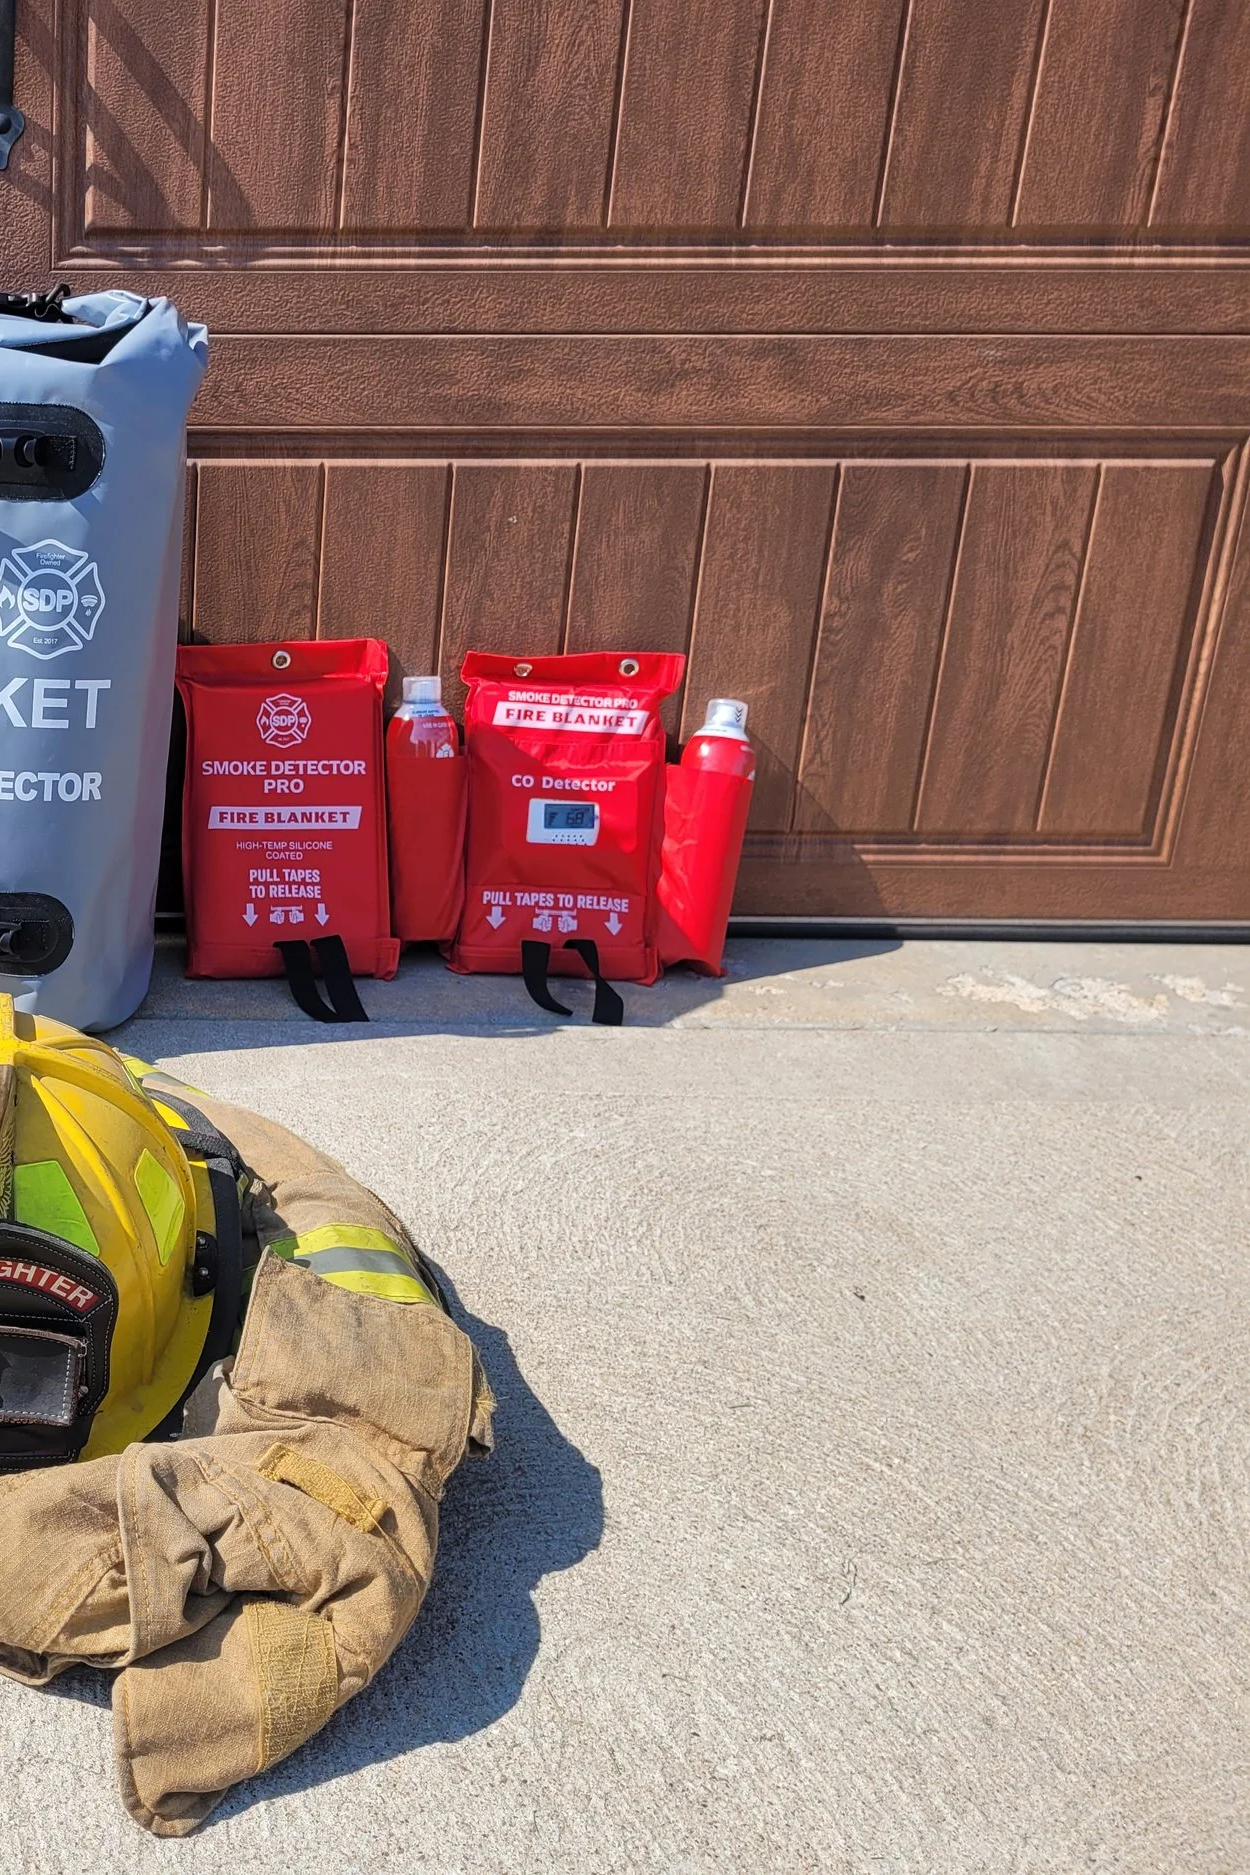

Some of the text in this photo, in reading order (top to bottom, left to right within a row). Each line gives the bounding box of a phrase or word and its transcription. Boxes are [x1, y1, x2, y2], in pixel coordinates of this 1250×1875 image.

[35, 552, 66, 561] Firefighter
[40, 559, 61, 567] Owned
[22, 587, 74, 613] SDP
[508, 690, 638, 710] SMOKE DETECTOR PRO
[272, 715, 295, 727] SDP
[505, 708, 638, 728] FIRE BLANKET
[202, 760, 366, 776] SMOKE DETECTOR
[264, 779, 305, 794] PRO
[511, 774, 616, 792] CO Detector
[218, 811, 350, 824] FIRE BLANKET
[236, 841, 333, 850] HIGH-TEMP SILICONE
[265, 851, 303, 860] COATED
[249, 869, 320, 883] PULL TAPES
[249, 885, 322, 899] TO RELEASE
[482, 891, 629, 913] PULL TAPES TO RELEASE
